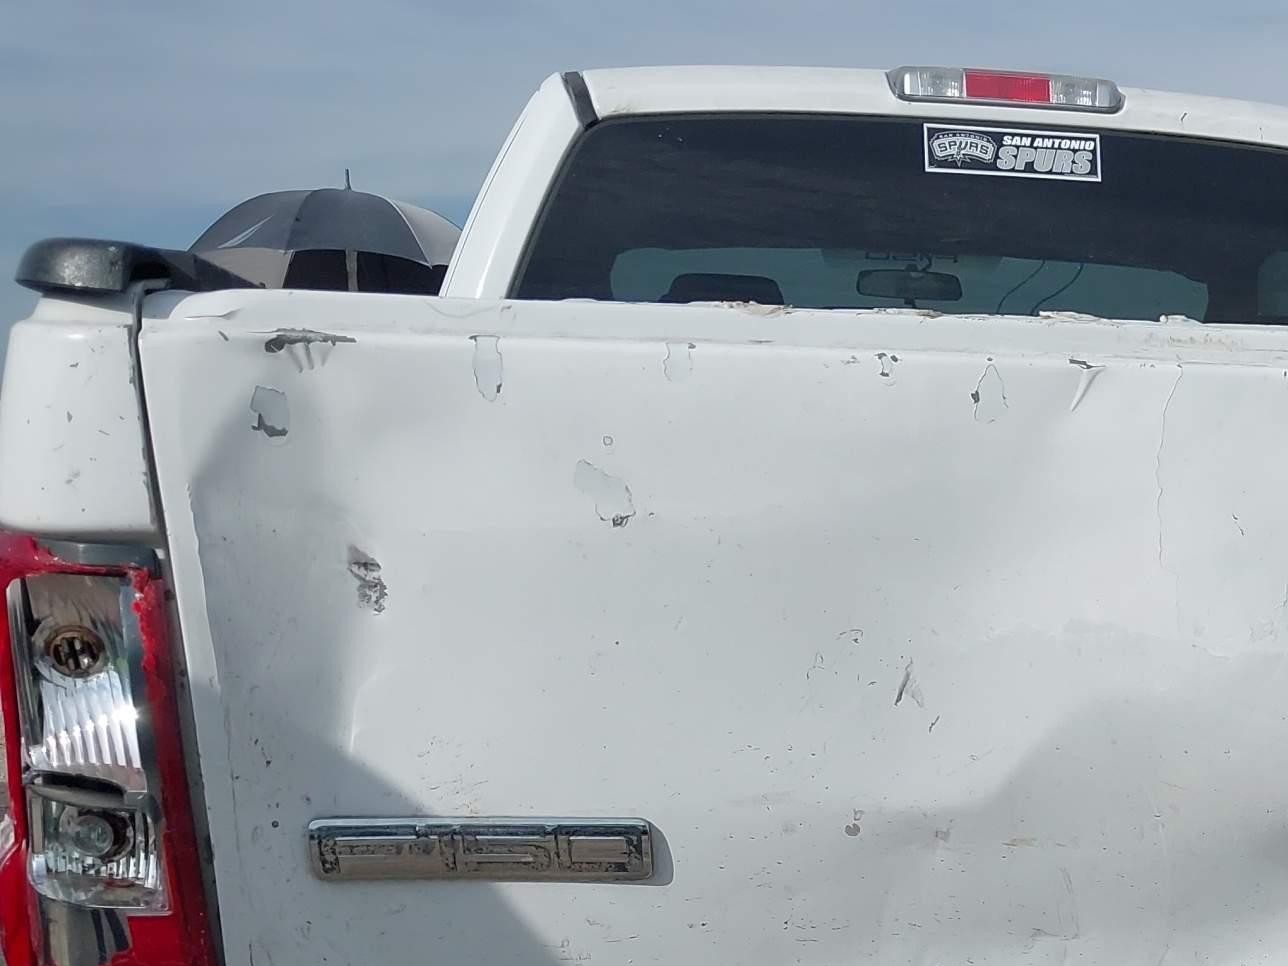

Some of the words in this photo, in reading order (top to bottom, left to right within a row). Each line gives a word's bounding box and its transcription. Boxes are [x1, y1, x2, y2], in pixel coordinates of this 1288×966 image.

[937, 140, 990, 156] SPURS
[1002, 135, 1032, 146] SAN
[1033, 137, 1095, 151] ANTONIO
[996, 146, 1093, 174] SPURS
